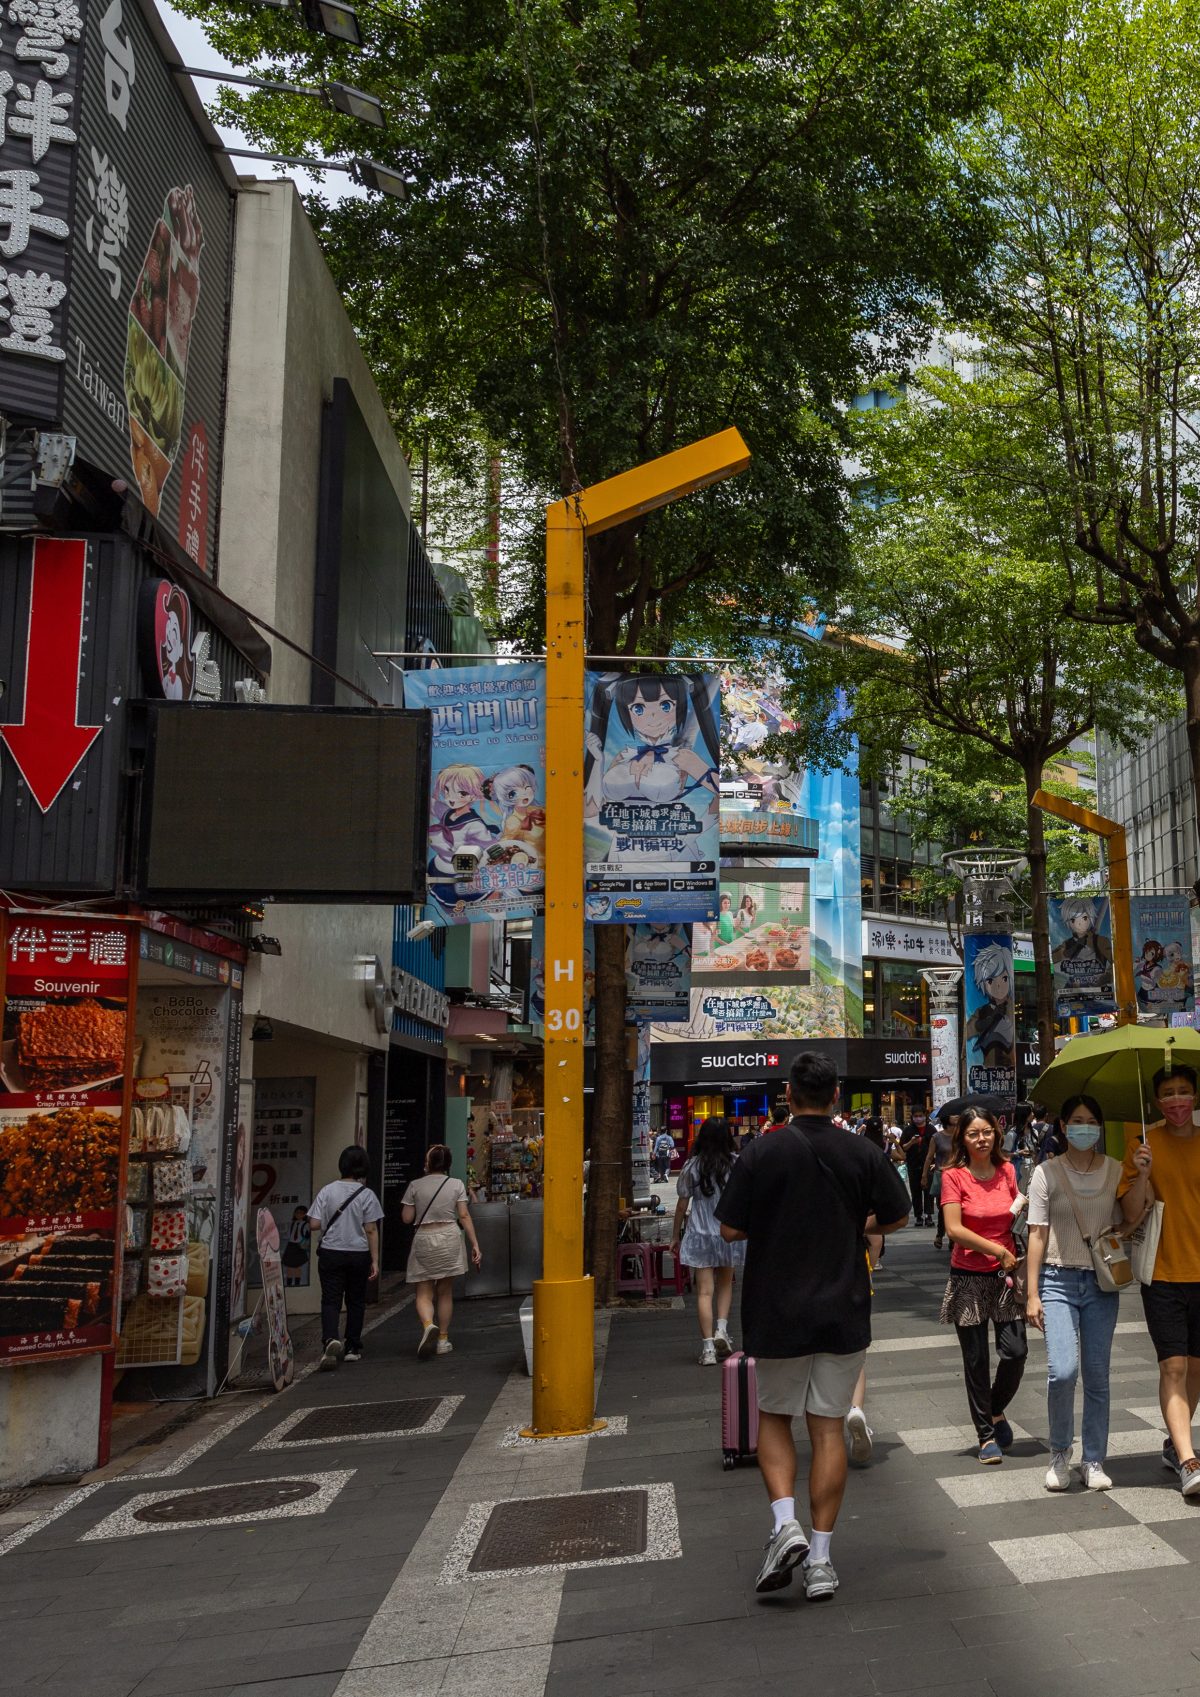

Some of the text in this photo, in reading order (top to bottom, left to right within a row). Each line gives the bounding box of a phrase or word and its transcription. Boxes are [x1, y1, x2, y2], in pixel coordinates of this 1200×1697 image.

[75, 335, 126, 433] Taiwan
[431, 698, 539, 737] 西門町
[433, 739, 480, 748] Welcome
[506, 734, 538, 744] Ximen
[605, 804, 691, 822] 在地下城尋求邂逅
[612, 819, 689, 831] 是否搞錯了什麼
[590, 864, 623, 872] 地城戰記
[8, 926, 127, 966] 伴手禮
[554, 960, 574, 982] H
[34, 978, 101, 994] Souvenir
[169, 996, 203, 1007] BoBo
[154, 1006, 217, 1017] Chocolate
[547, 1008, 580, 1031] 30
[701, 1053, 766, 1068] swatch
[885, 1051, 921, 1064] swatch
[1024, 1052, 1040, 1066] LUS
[25, 1225, 53, 1233] Seaweed
[54, 1223, 67, 1231] Pork
[8, 1343, 37, 1353] Seaweed
[37, 1341, 57, 1349] Crispy
[57, 1339, 71, 1347] Pork
